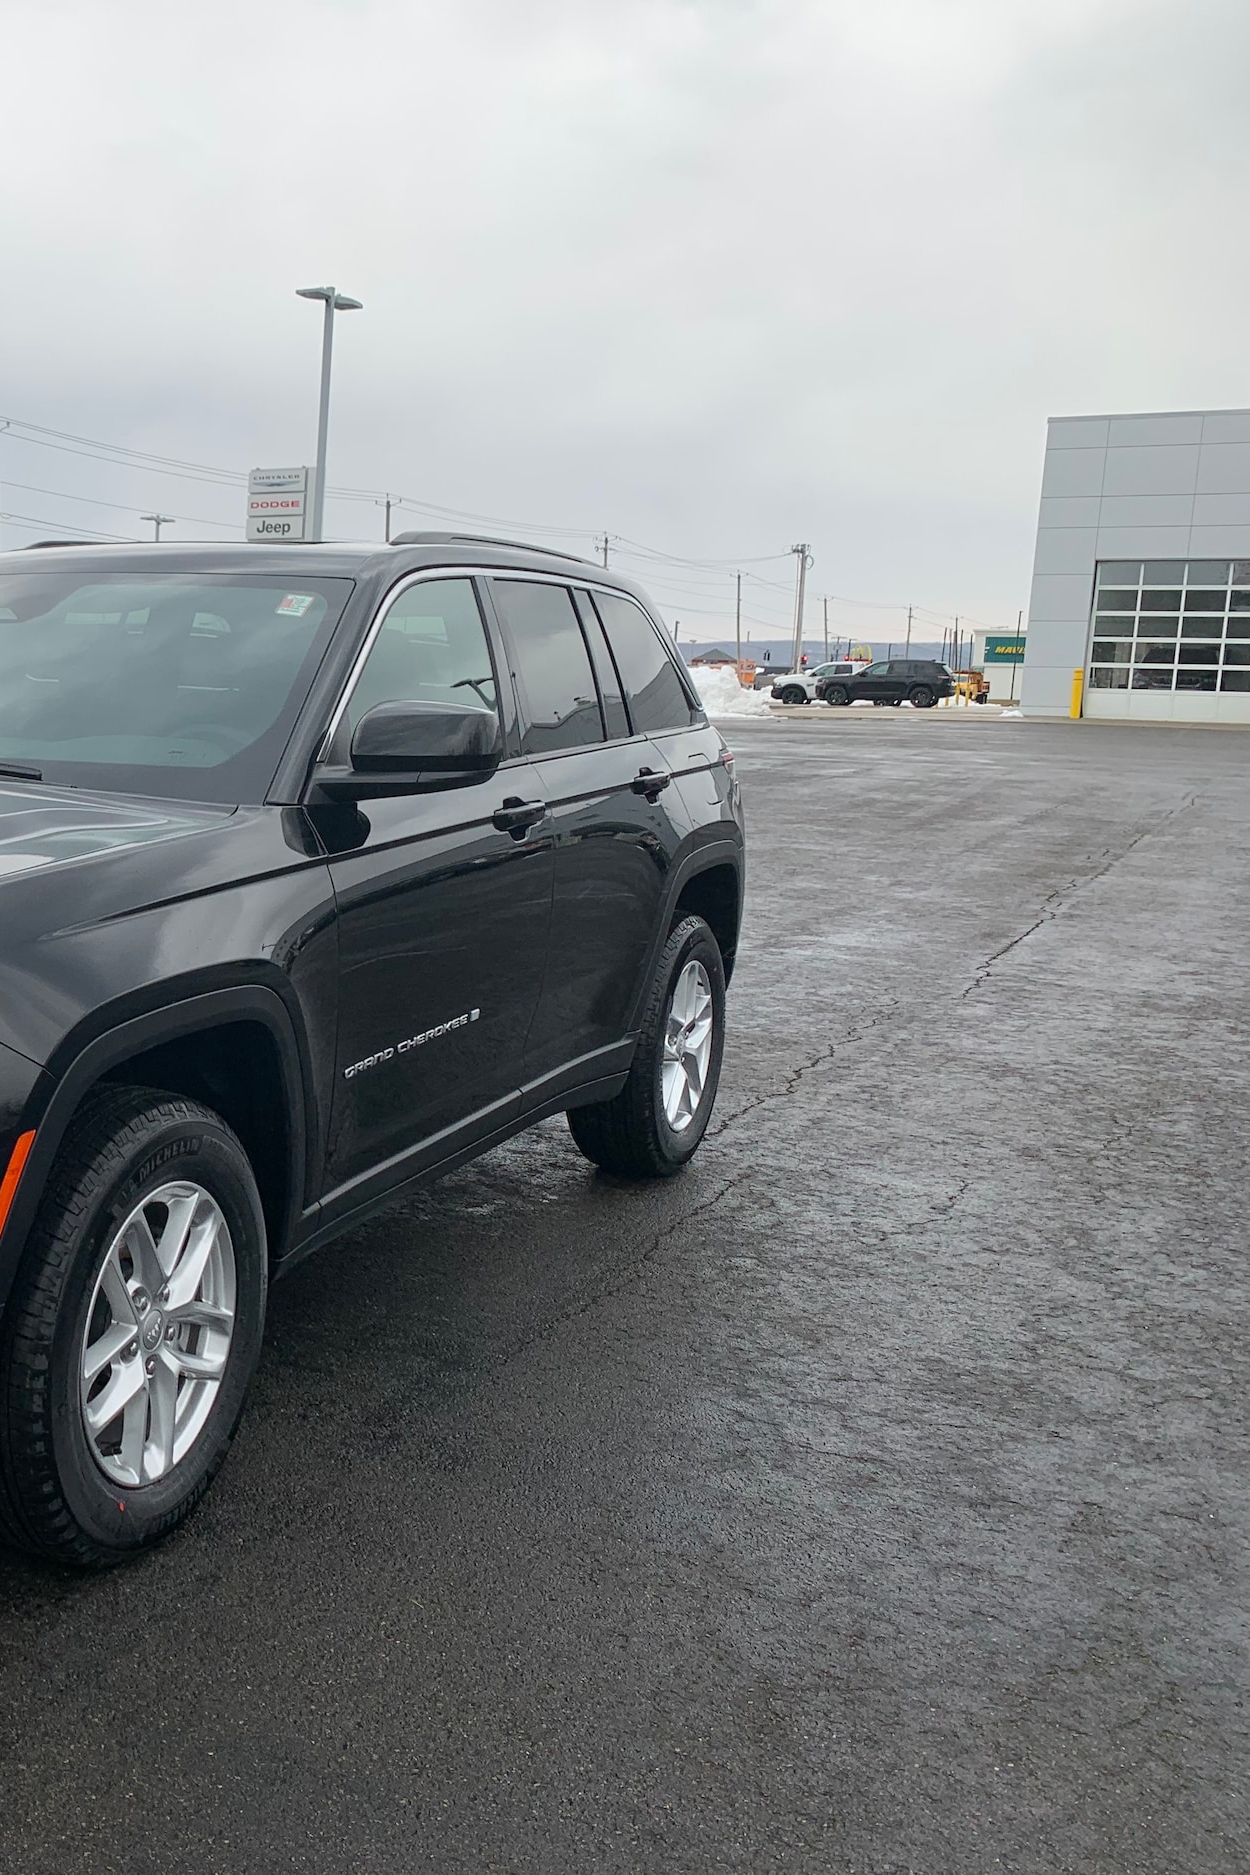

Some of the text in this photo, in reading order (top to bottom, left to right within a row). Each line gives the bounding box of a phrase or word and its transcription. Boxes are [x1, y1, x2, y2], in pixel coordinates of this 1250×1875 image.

[250, 500, 300, 509] DODGE
[256, 520, 291, 536] Jeep
[344, 1013, 469, 1079] GRAND CHEROKEE
[138, 1137, 200, 1183] MICHELIN
